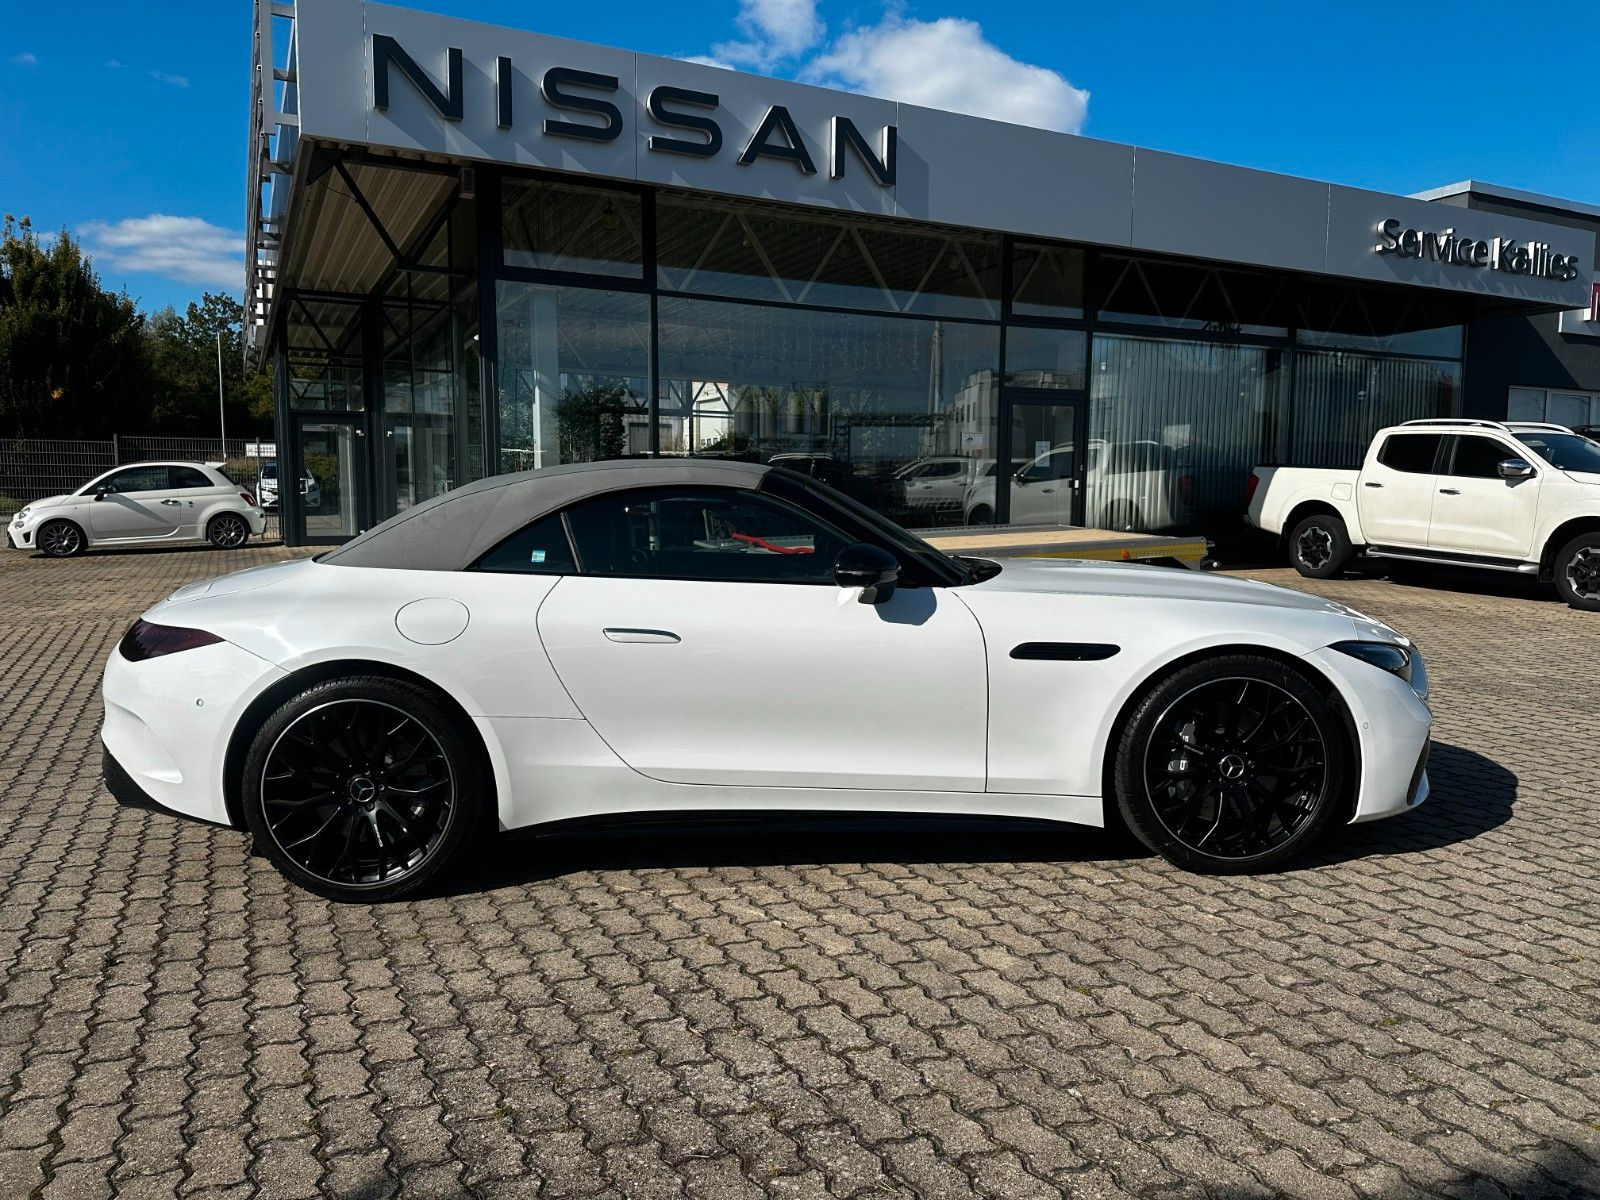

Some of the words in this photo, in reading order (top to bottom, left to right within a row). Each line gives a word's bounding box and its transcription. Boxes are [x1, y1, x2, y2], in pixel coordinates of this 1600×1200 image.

[372, 33, 897, 186] NISSAN
[1375, 219, 1488, 267] Service
[1491, 237, 1579, 281] Kallies
